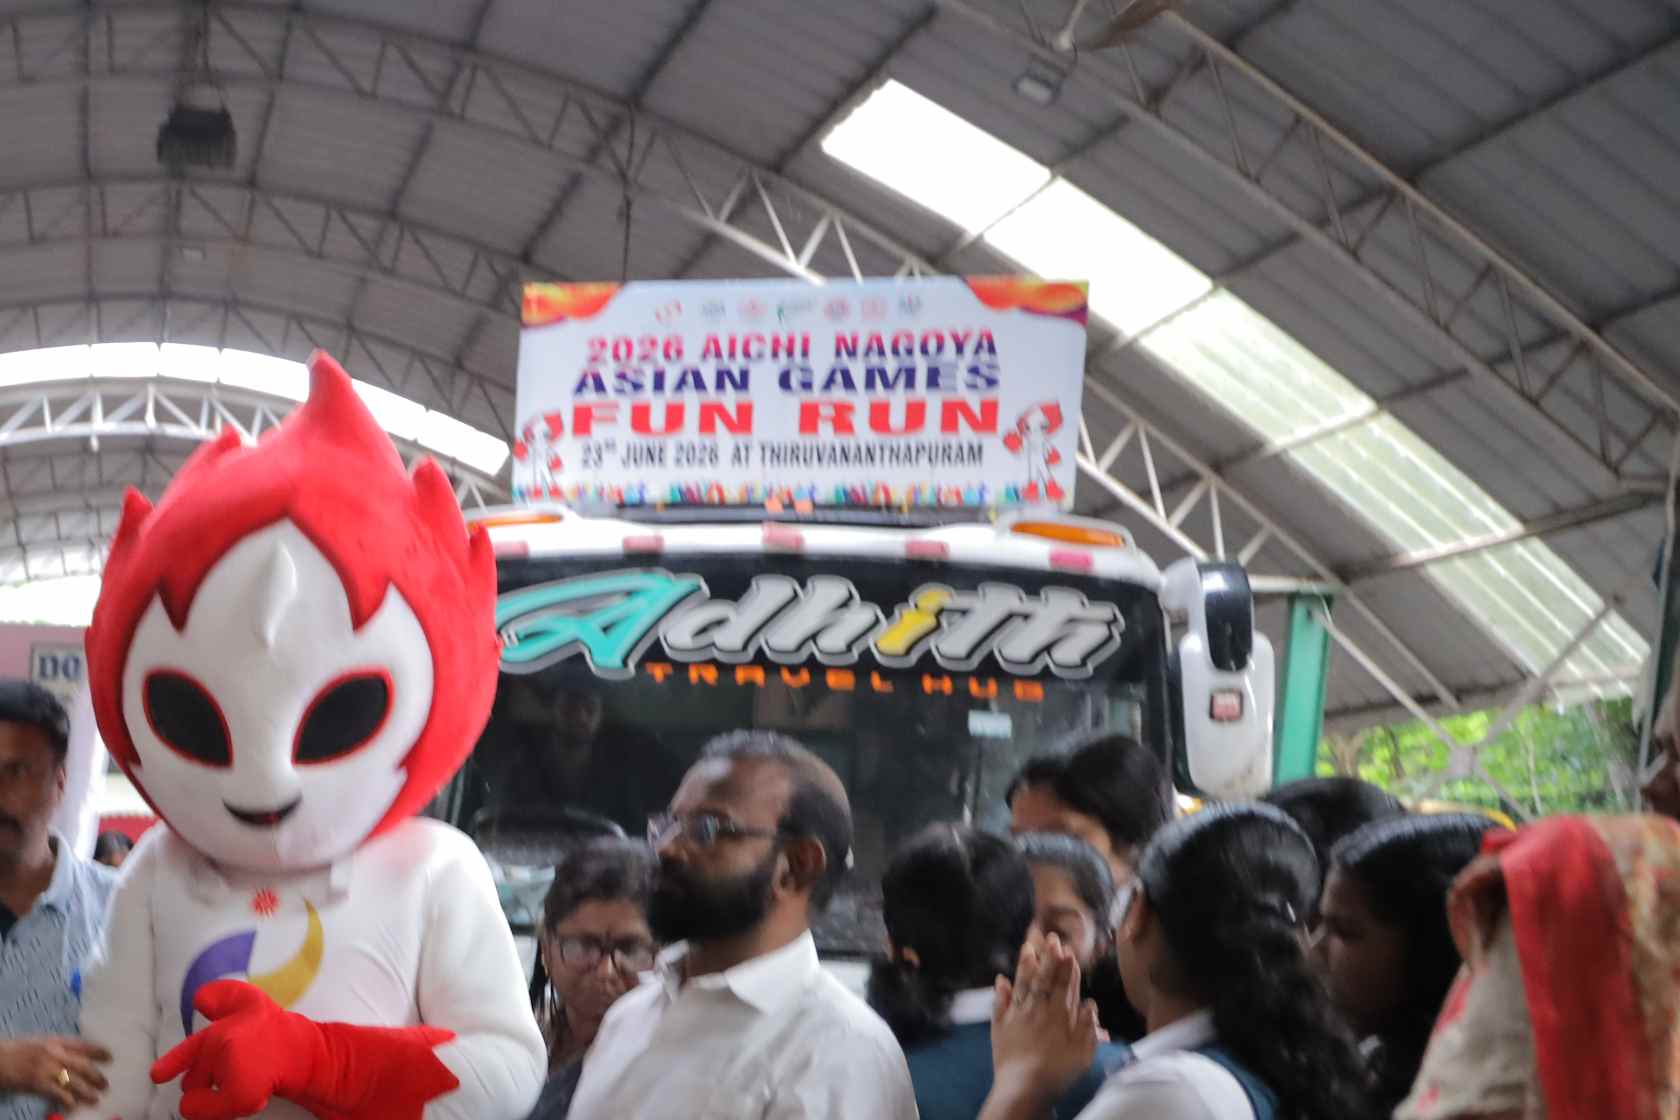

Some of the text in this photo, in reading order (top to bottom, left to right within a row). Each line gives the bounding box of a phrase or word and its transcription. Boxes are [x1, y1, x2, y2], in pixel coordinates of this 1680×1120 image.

[586, 328, 998, 365] 2026 AICHI NAGOYA
[573, 363, 1000, 396] ASIAN GAMES
[572, 398, 999, 437] FUN RUN
[621, 442, 666, 469] JUNE
[730, 442, 754, 468] AT
[646, 660, 1044, 703] TRAVEL HUB
